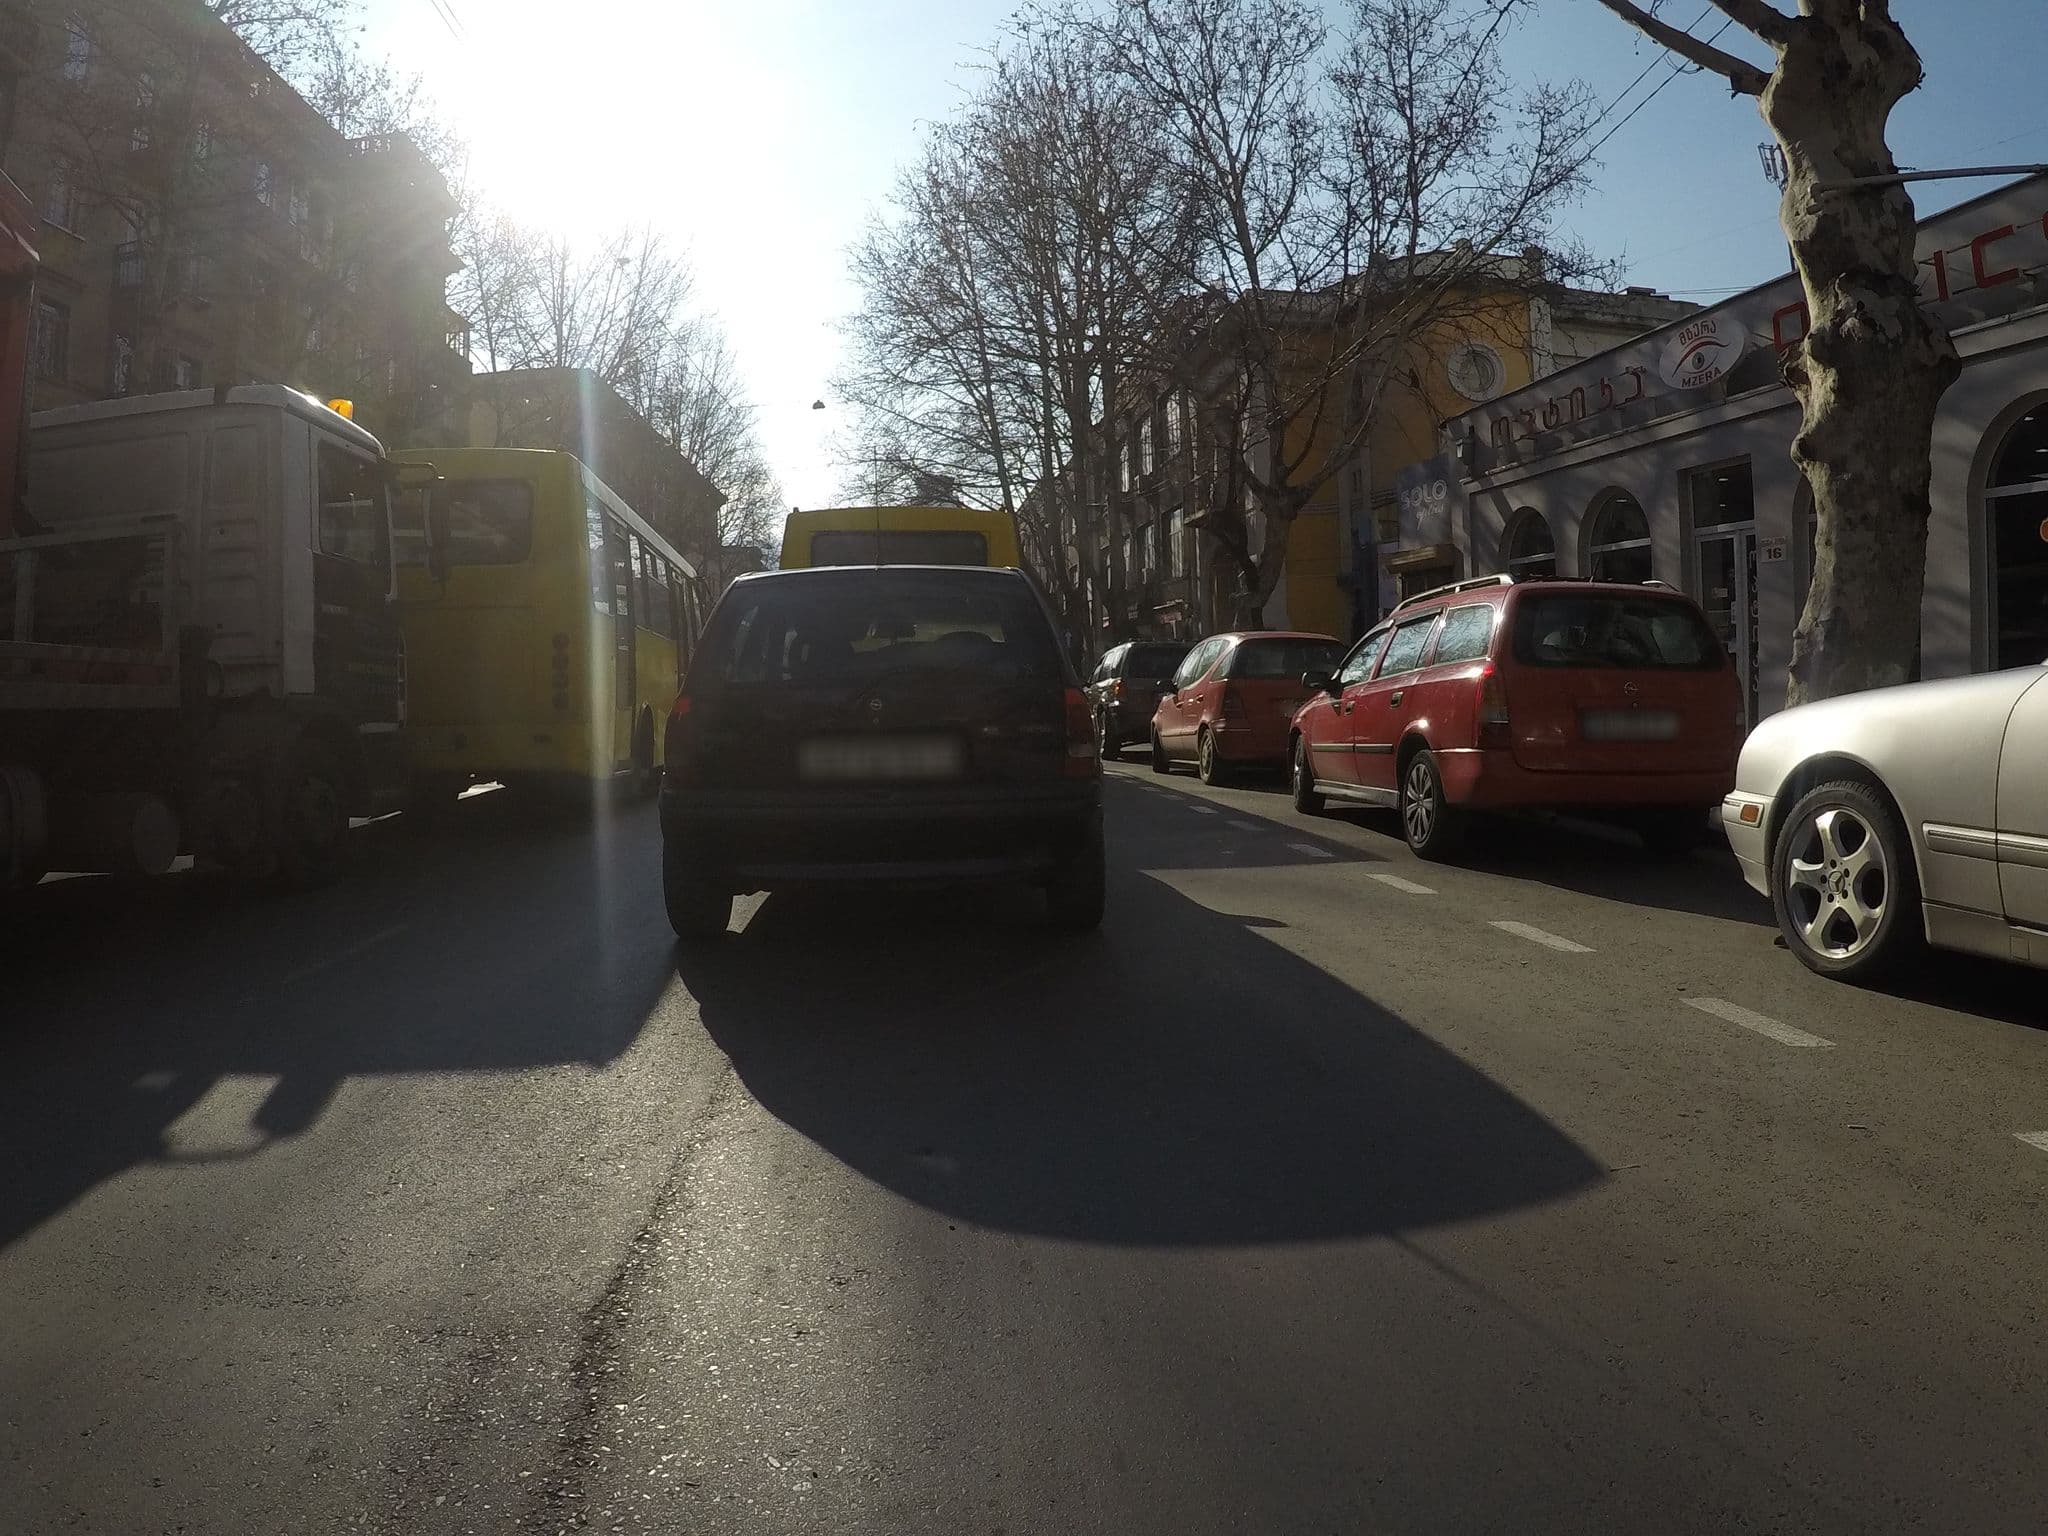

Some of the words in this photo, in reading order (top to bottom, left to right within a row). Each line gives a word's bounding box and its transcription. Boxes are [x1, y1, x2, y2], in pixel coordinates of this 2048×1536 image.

[1681, 366, 1722, 388] MZERA
[1400, 479, 1448, 512] SOLO
[1766, 547, 1782, 560] 16
